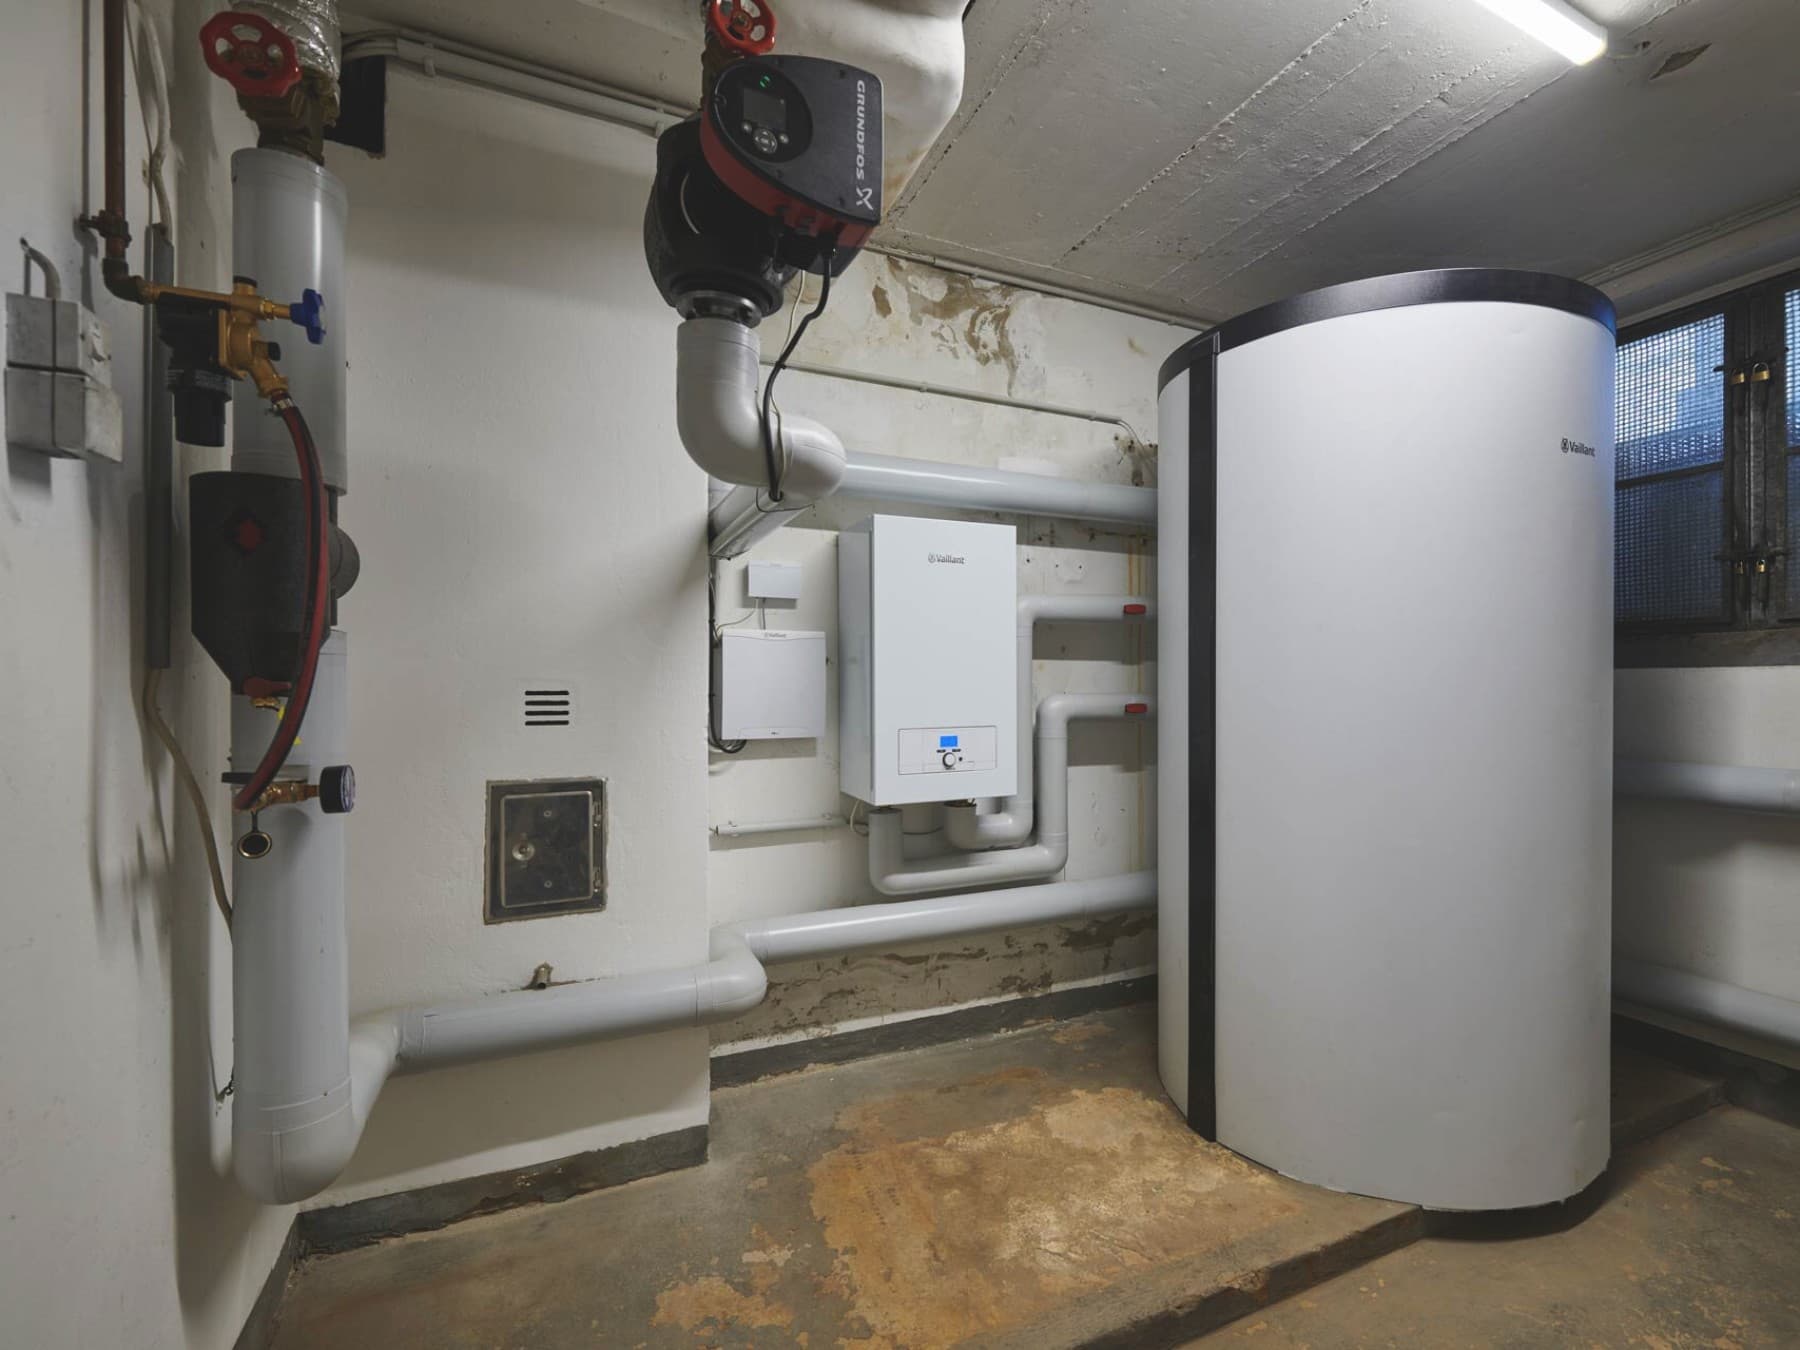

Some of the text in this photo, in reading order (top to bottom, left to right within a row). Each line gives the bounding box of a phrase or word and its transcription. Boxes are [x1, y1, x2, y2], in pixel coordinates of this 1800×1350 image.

[856, 79, 866, 181] GRUNDFOS
[1569, 441, 1595, 457] Vaillant
[936, 554, 964, 564] Vaillant
